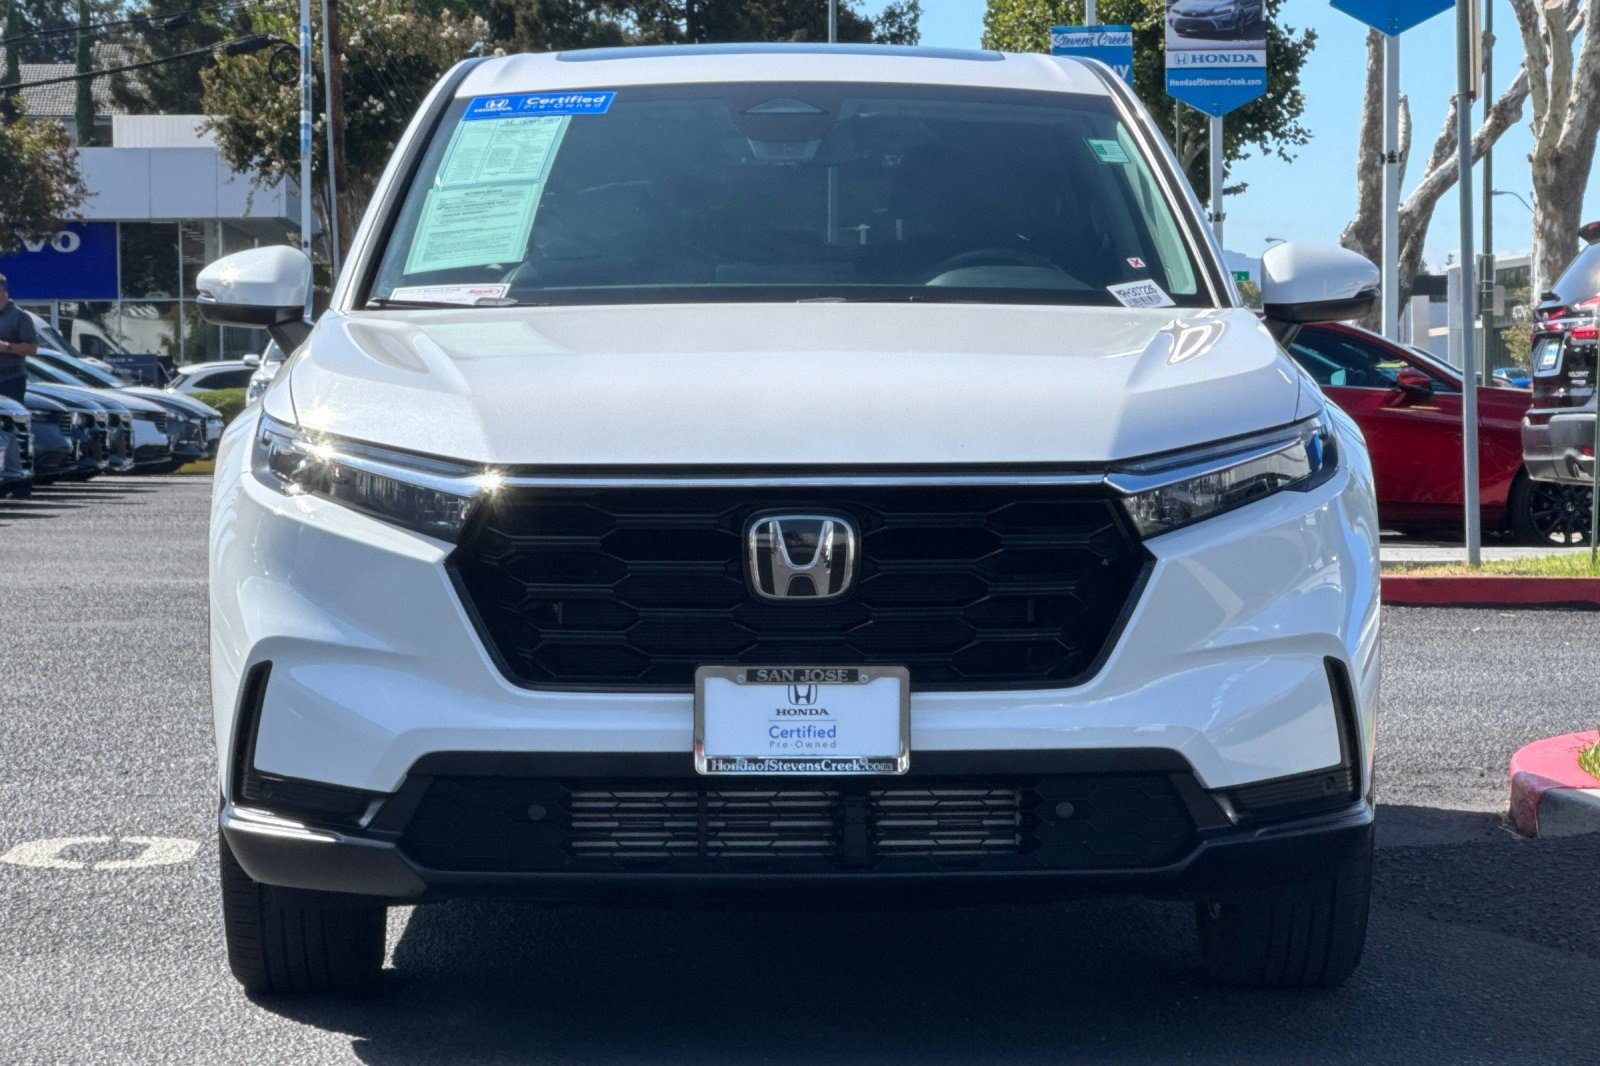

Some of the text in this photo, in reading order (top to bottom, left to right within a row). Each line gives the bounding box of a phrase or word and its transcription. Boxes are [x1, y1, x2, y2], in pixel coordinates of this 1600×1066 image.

[1055, 32, 1130, 46] Stevens Creek
[1191, 54, 1258, 64] HONDA
[1169, 78, 1262, 87] HondaofStevensCreek.com
[526, 95, 606, 105] Certified
[756, 669, 849, 682] SAN JOSE
[775, 708, 830, 717] HONDA
[768, 725, 837, 739] Certified
[769, 740, 837, 749] Pre-Owned
[711, 759, 894, 771] HondaofStevensCreek.com
